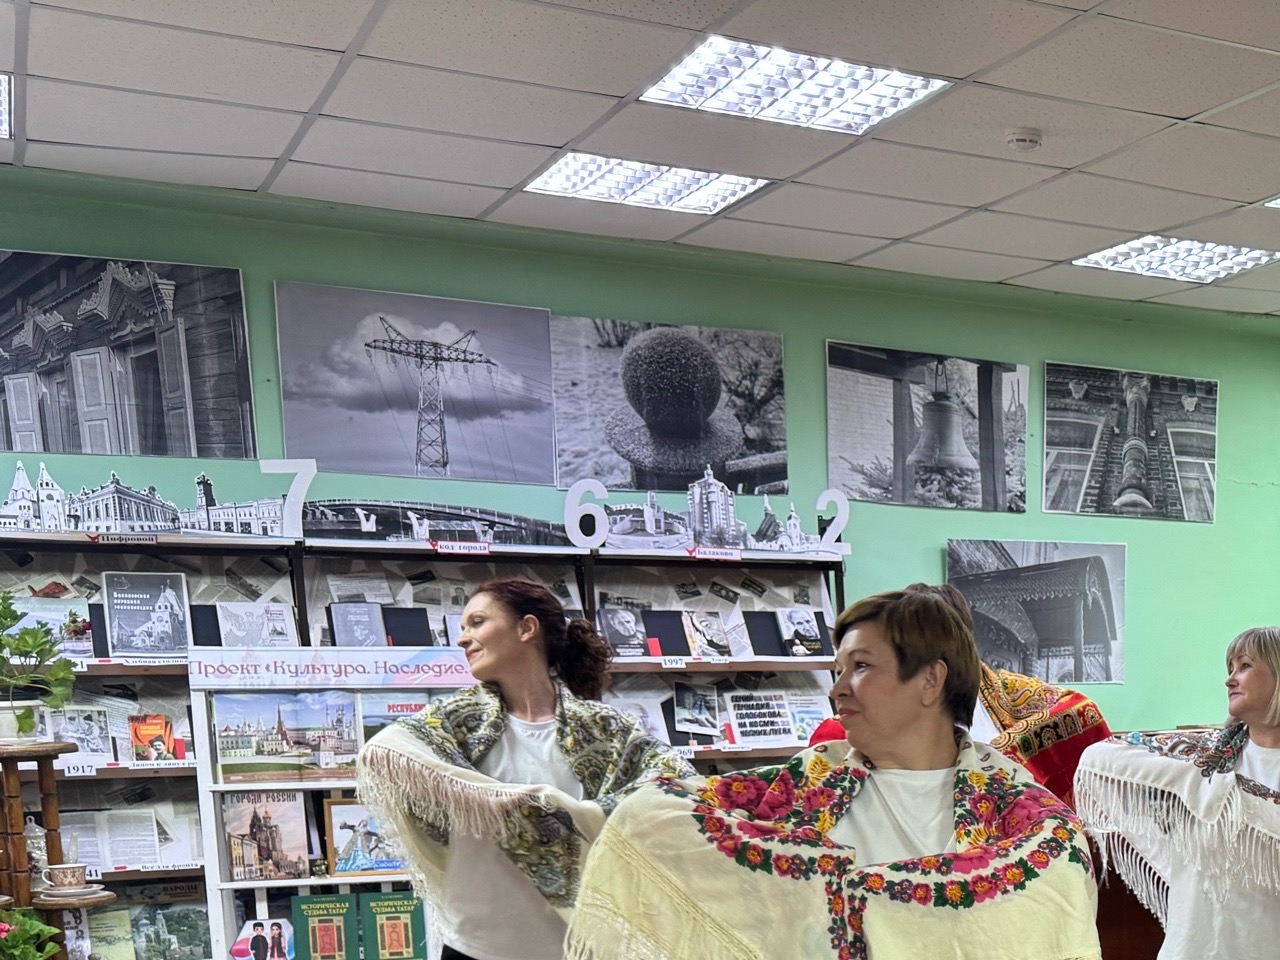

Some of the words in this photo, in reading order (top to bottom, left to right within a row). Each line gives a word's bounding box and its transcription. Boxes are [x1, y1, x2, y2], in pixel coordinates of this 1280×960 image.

[259, 459, 318, 538] 7
[564, 478, 609, 549] 6
[816, 489, 852, 556] 2
[101, 534, 155, 544] Цифровой
[188, 660, 261, 677] Проект
[375, 660, 468, 677] Наследие.
[663, 658, 684, 667] 1997
[387, 703, 426, 713] РЕСПУБЛИ
[66, 764, 94, 775] 1917
[230, 793, 263, 805] ГОРОДА
[265, 791, 297, 803] РОССИИ
